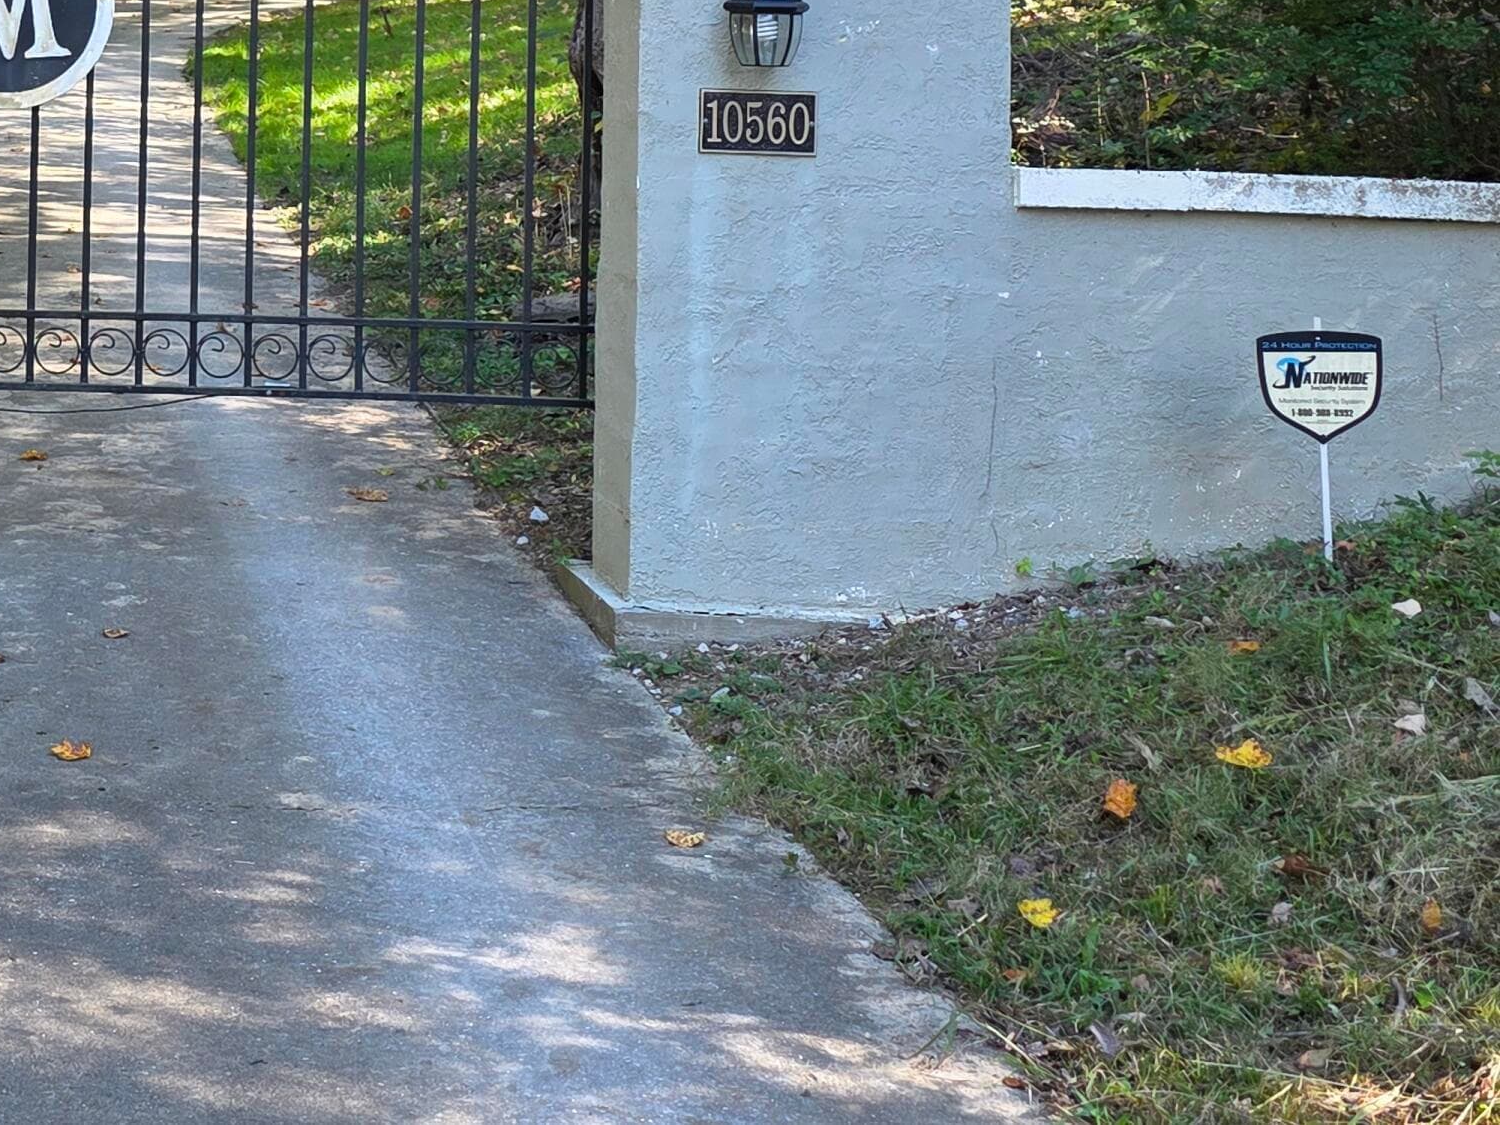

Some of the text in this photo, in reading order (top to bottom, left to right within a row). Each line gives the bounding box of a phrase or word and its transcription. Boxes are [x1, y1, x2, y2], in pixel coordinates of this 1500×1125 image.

[706, 99, 810, 145] 10560
[1261, 341, 1278, 349] 24
[1273, 356, 1369, 389] NATIONWIDE
